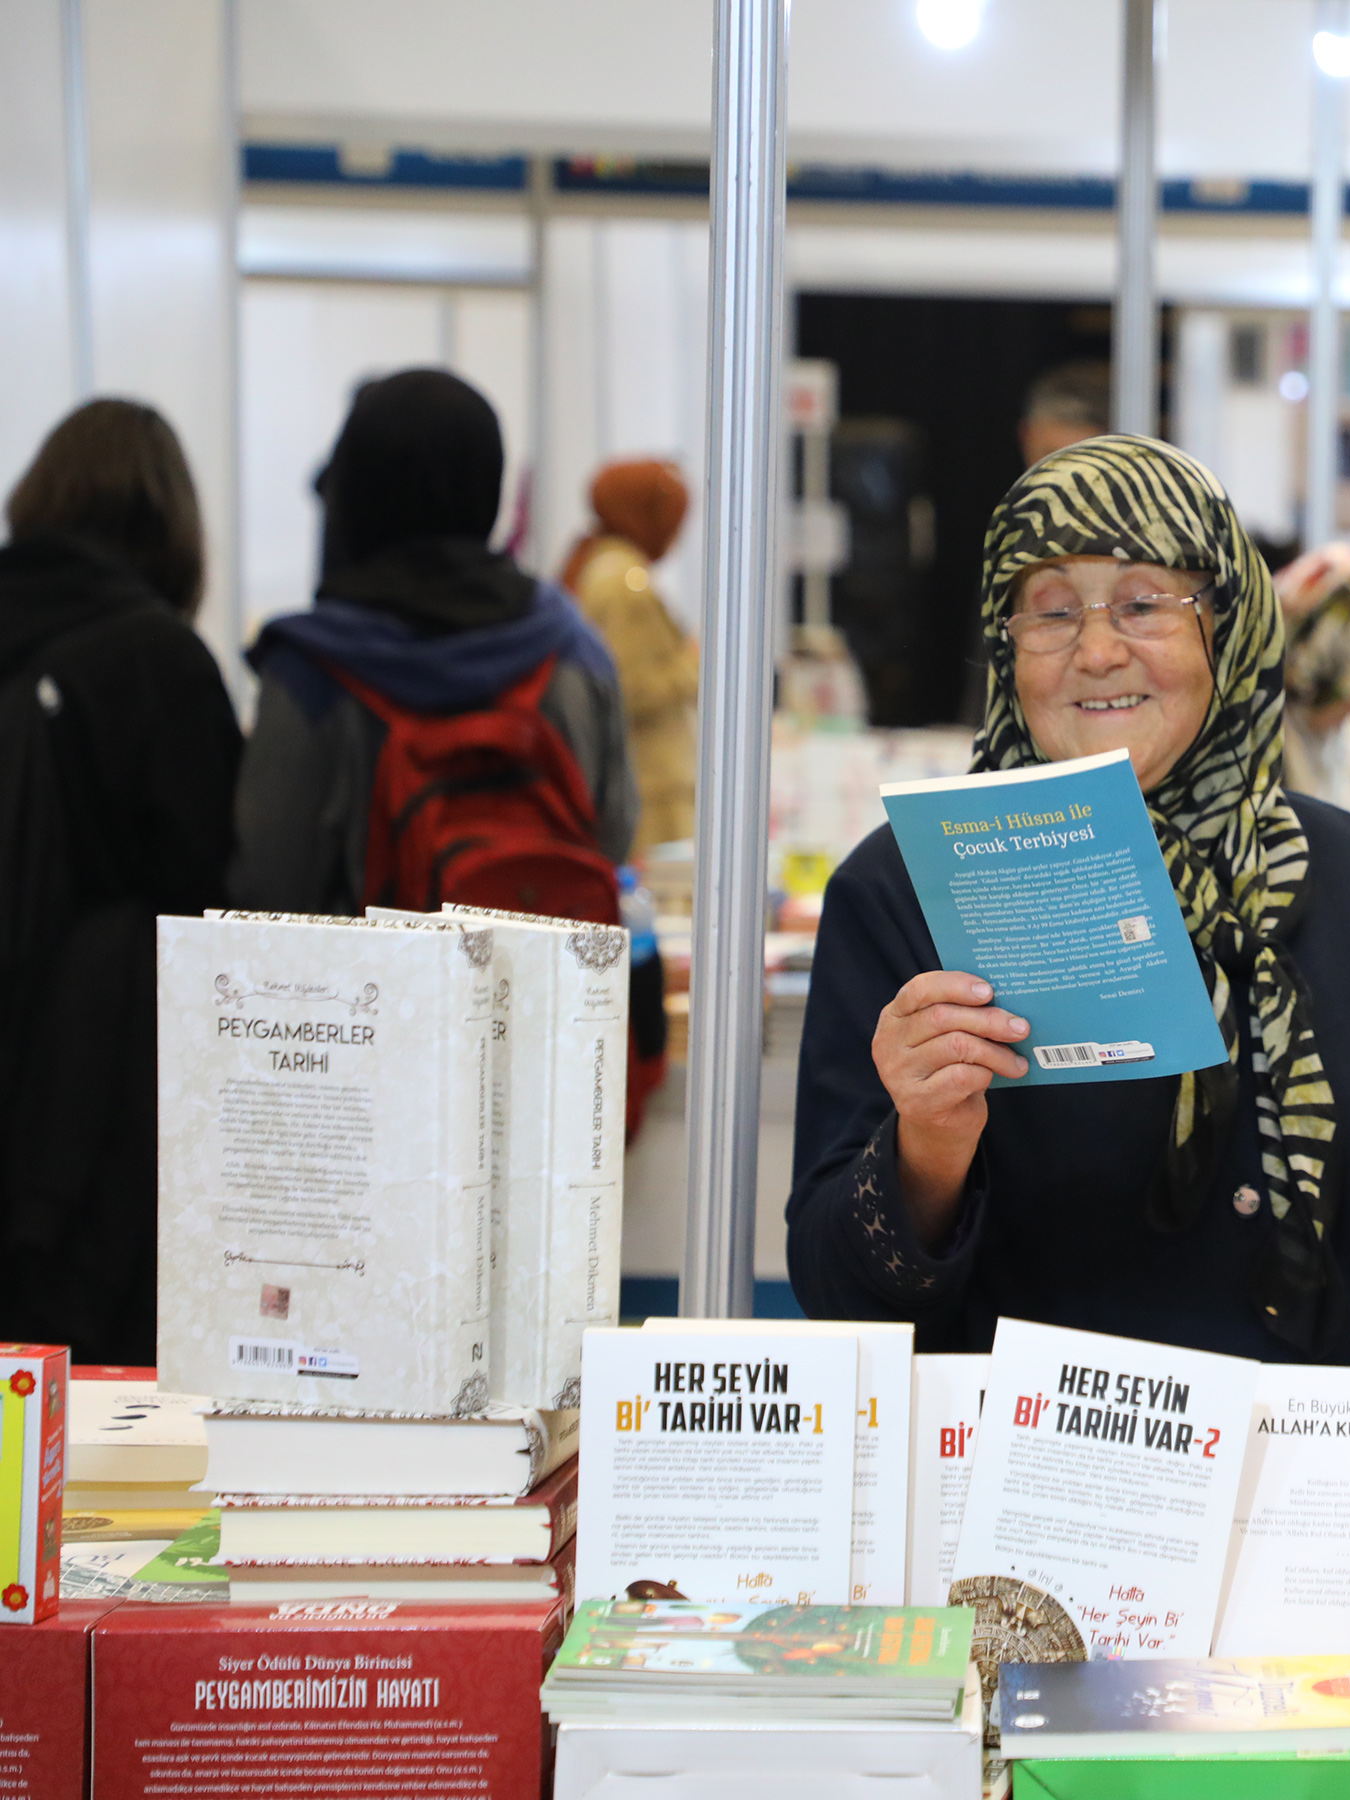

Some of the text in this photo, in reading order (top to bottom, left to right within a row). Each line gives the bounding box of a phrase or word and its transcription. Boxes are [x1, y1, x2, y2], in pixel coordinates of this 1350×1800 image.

[941, 803, 1093, 836] Esma-i Hüsna ile
[953, 824, 1095, 859] Çocuk Terbiyesi
[217, 1017, 375, 1046] PEYGAMBERLER
[269, 1050, 329, 1074] TARİHİ
[592, 1038, 605, 1131] PEYGAMBERLER
[591, 1134, 602, 1171] TARİHİ
[588, 1196, 601, 1255] Mehmet
[586, 1258, 599, 1312] Dikmen
[654, 1357, 789, 1397] HER ŞEYİN
[1058, 1363, 1190, 1415] HER ŞEYİN
[616, 1394, 651, 1432] Bİ'
[658, 1396, 742, 1433] TARİHİ
[750, 1401, 823, 1434] VAR-1
[1288, 1398, 1306, 1414] En
[940, 1422, 973, 1458] Bİ'
[1013, 1393, 1221, 1459] Bİ' TARİHİ VAR-2
[1257, 1417, 1331, 1438] ALLAH'A
[1116, 1609, 1157, 1630] Şeyin
[1089, 1630, 1130, 1647] Tarihi
[218, 1652, 413, 1674] Siyer Ödülü Dünya Birincisi
[194, 1675, 440, 1711] PEYGAMBERİMİZİN HAYATI
